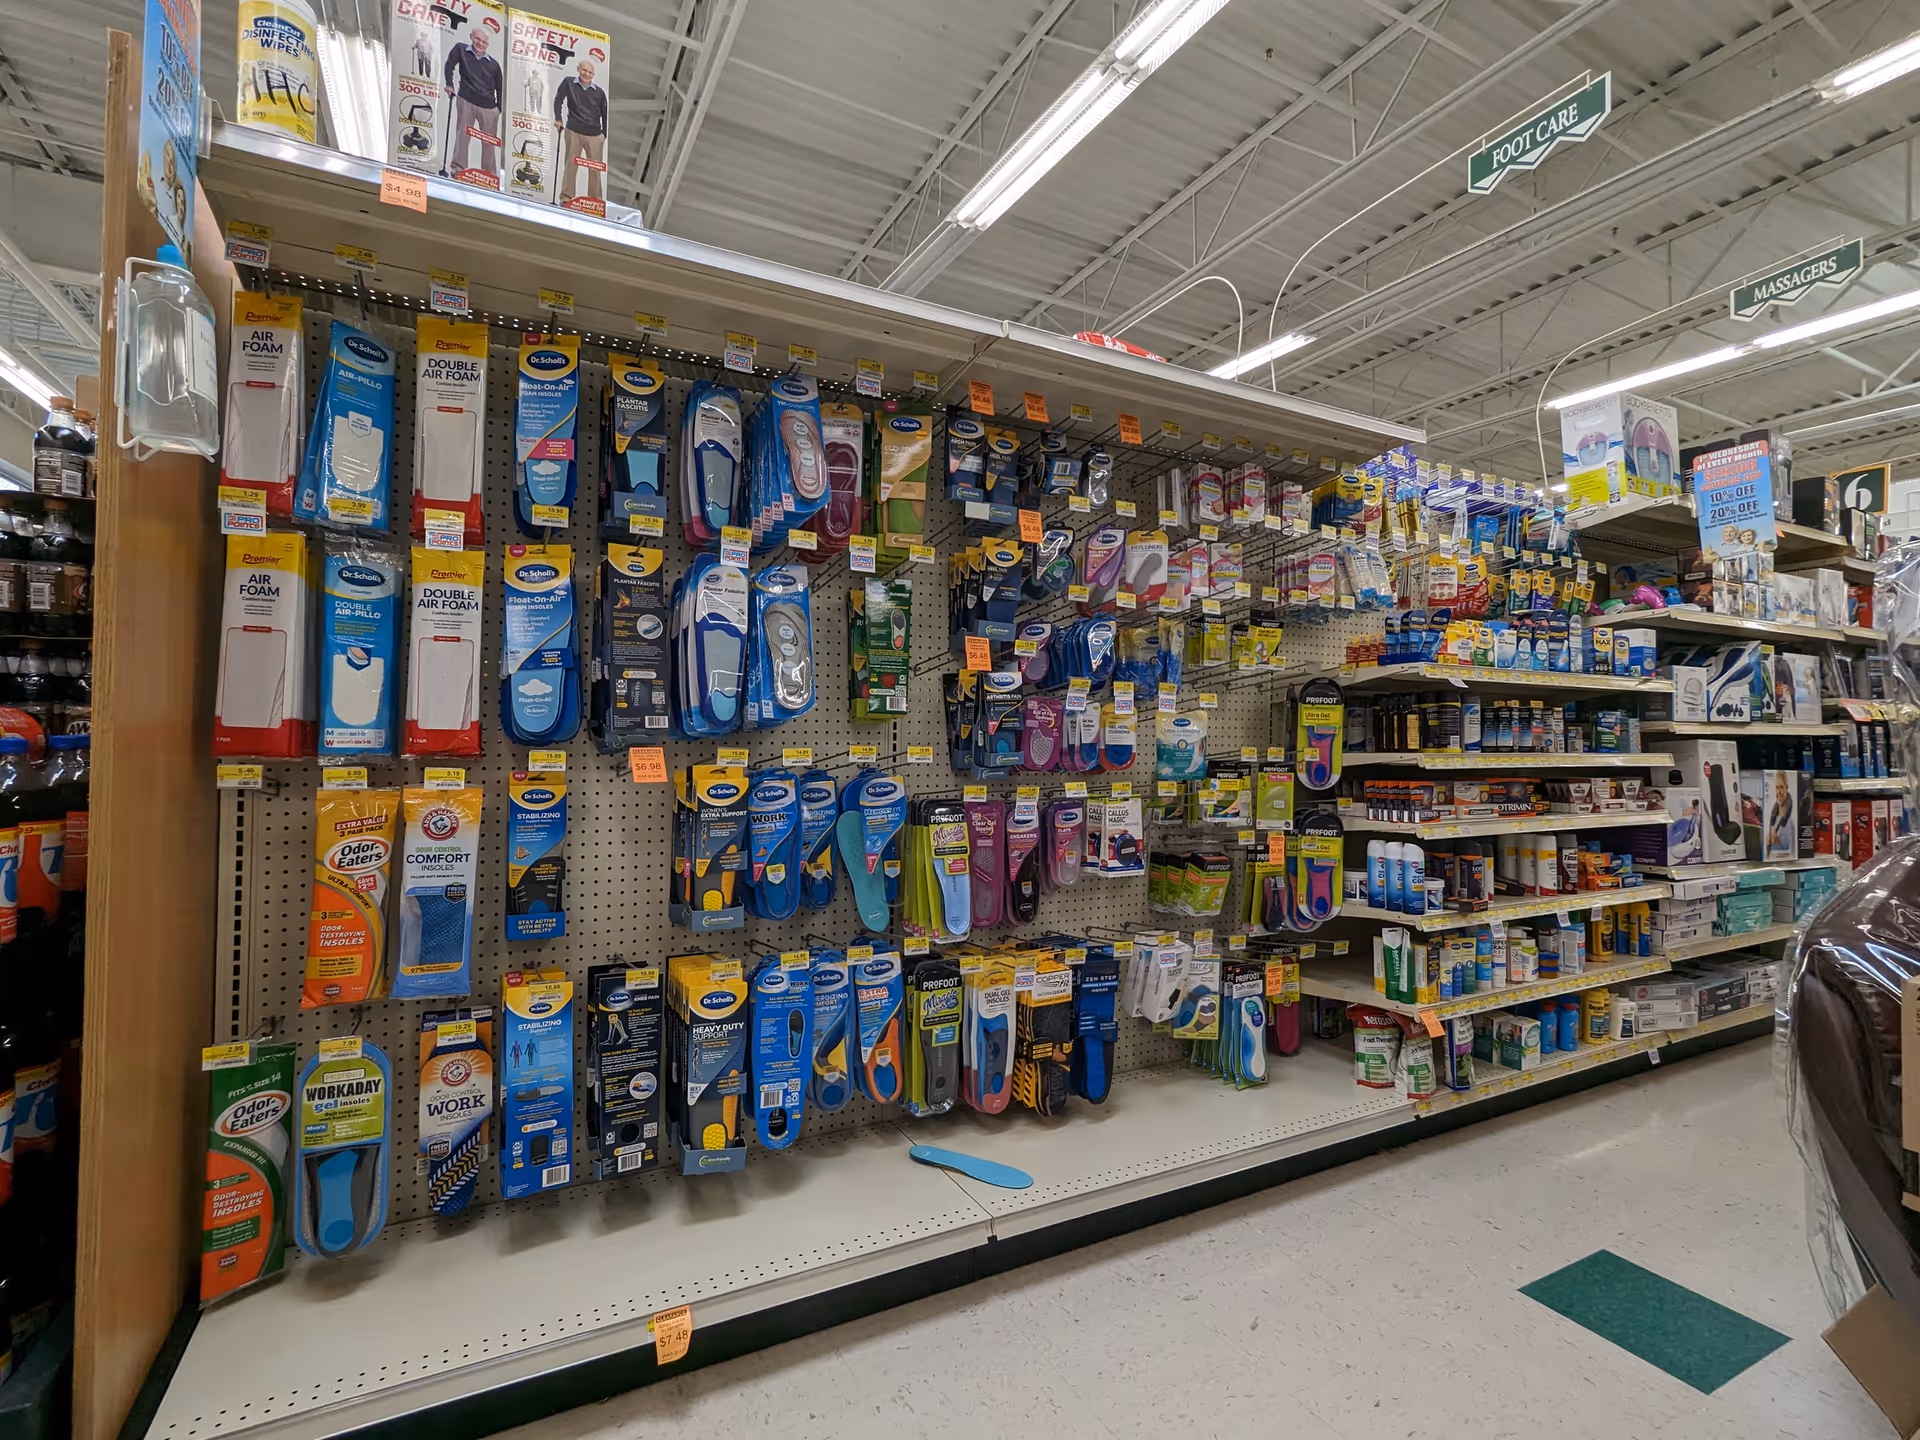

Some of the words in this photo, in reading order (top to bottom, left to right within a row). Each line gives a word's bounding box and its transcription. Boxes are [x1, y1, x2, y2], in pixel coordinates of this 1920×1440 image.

[512, 22, 579, 50] SAFETY
[242, 28, 316, 62] DISINFECTING
[511, 38, 558, 63] CANE
[398, 83, 421, 95] 300
[422, 88, 440, 100] LBS
[511, 119, 533, 131] 300
[1492, 127, 1534, 170] FOOT
[1536, 102, 1579, 142] CARE
[385, 182, 422, 198] $4.98
[1753, 255, 1838, 303] MASSAGERS
[245, 311, 283, 324] Premier
[251, 330, 274, 342] AIR
[242, 341, 283, 354] FOAM
[347, 339, 386, 361] Dr.Scholl's
[435, 339, 472, 351] Premier
[428, 358, 478, 372] DOUBLE
[529, 355, 567, 367] Dr.Scholl's
[337, 368, 383, 391] AIR-PILLO
[421, 367, 443, 379] AIR
[445, 369, 482, 383] FOAM
[625, 373, 653, 387] Dr.Scholl's
[616, 396, 648, 406] PLANTAR
[892, 420, 921, 429] Dr.Scholl's
[950, 438, 965, 446] ARCH
[1709, 441, 1760, 461] WEDNESDAY
[1707, 457, 1732, 468] EVERY
[1734, 449, 1763, 462] Month
[305, 491, 316, 500] M
[1709, 490, 1733, 503] 10%
[1735, 483, 1756, 497] OFF
[1844, 473, 1873, 510] 6
[303, 501, 315, 510] W
[1710, 506, 1736, 519] 20%
[1738, 500, 1759, 513] OFF
[227, 521, 261, 530] POINTS
[238, 516, 261, 525] PRO
[1022, 524, 1041, 533] $6.48
[439, 534, 459, 543] PRO
[242, 554, 283, 565] Premier
[248, 574, 271, 585] AIR
[342, 570, 382, 583] Dr.Scholl's
[430, 568, 468, 580] Premier
[518, 568, 556, 580] Dr.Scholl's
[239, 584, 280, 597] FOAM
[423, 588, 475, 601] DOUBLE
[417, 599, 440, 610] AIR
[442, 599, 479, 611] FOAM
[508, 594, 563, 604] Float-On-Air
[335, 601, 373, 611] DOUBLE
[529, 603, 554, 611] INSOLES
[335, 609, 381, 619] AIR-PILLO
[1595, 638, 1611, 646] MAX
[968, 650, 989, 660] $6.48
[1305, 696, 1338, 704] PROFOOT
[325, 729, 334, 737] M
[635, 761, 662, 771] $6.98
[708, 787, 738, 796] Dr.Scholl's
[756, 789, 786, 799] Dr.Scholl's
[867, 784, 897, 794] Dr.Scholl's
[524, 792, 553, 801] Dr.Scholl's
[516, 811, 561, 820] STABILIZING
[700, 811, 720, 819] EXTRA
[720, 809, 748, 818] SUPPORT
[751, 812, 787, 824] WORK
[1107, 809, 1129, 817] CALLUS
[336, 820, 361, 831] EXTRA
[361, 815, 387, 827] VALUE
[1107, 816, 1127, 824] MAGIC
[339, 830, 345, 838] 3
[347, 827, 364, 836] PAIR
[365, 824, 384, 834] PACK
[1009, 832, 1037, 840] SNEAKERS
[1305, 828, 1338, 837] PROFOOT
[340, 841, 380, 858] Odor-
[336, 851, 383, 870] Eaters
[406, 852, 471, 865] COMFORT
[421, 863, 455, 871] INSOLES
[1207, 863, 1231, 872] PROFOOT
[357, 876, 375, 886] SAVE
[327, 874, 372, 911] ULTRA-COMFORT
[517, 918, 534, 926] STAY
[535, 917, 557, 925] ACTIVE
[320, 924, 345, 933] ODOR-
[320, 929, 366, 940] DESTROYING
[521, 927, 553, 935] STABILITY
[320, 936, 365, 947] INSOLES
[865, 962, 893, 975] Dr.Scholl's
[812, 972, 842, 982] Dr.Scholl's
[1035, 971, 1070, 984] COPPER
[1099, 974, 1117, 982] STEP
[544, 984, 561, 992] 15.99
[788, 979, 810, 989] WORK
[922, 977, 959, 991] PROFOOT
[1235, 981, 1262, 992] Soft-thetic
[857, 986, 888, 998] EXTRA
[984, 990, 999, 999] DUAL
[999, 988, 1012, 998] GEL
[1036, 987, 1067, 998] WORKGEAR
[702, 995, 735, 1005] Dr.Scholl's
[985, 995, 1010, 1005] INSOLES
[454, 1022, 472, 1031] 10.29
[517, 1018, 562, 1032] STABILIZING
[692, 1025, 722, 1036] HEAVY
[722, 1021, 745, 1032] DUTY
[692, 1029, 729, 1041] SUPPORT
[227, 1045, 244, 1053] 2.99
[342, 1039, 357, 1047] 7.99
[228, 1087, 246, 1099] FITS
[253, 1077, 271, 1090] SIZE
[270, 1072, 282, 1083] 14
[305, 1078, 382, 1102] WORKADAY
[429, 1093, 452, 1102] ODOR
[452, 1087, 482, 1099] CONTROL
[233, 1096, 276, 1119] Odor-
[313, 1098, 339, 1114] gel
[338, 1096, 371, 1107] insoles
[426, 1093, 486, 1118] WORK
[230, 1106, 281, 1133] Eaters
[440, 1109, 472, 1122] INSOLES
[223, 1140, 255, 1161] EXPANDED
[212, 1190, 241, 1203] ODOR-
[212, 1189, 265, 1210] DESTROYING
[212, 1196, 264, 1218] INSOLES
[659, 1329, 689, 1348] $7.48
